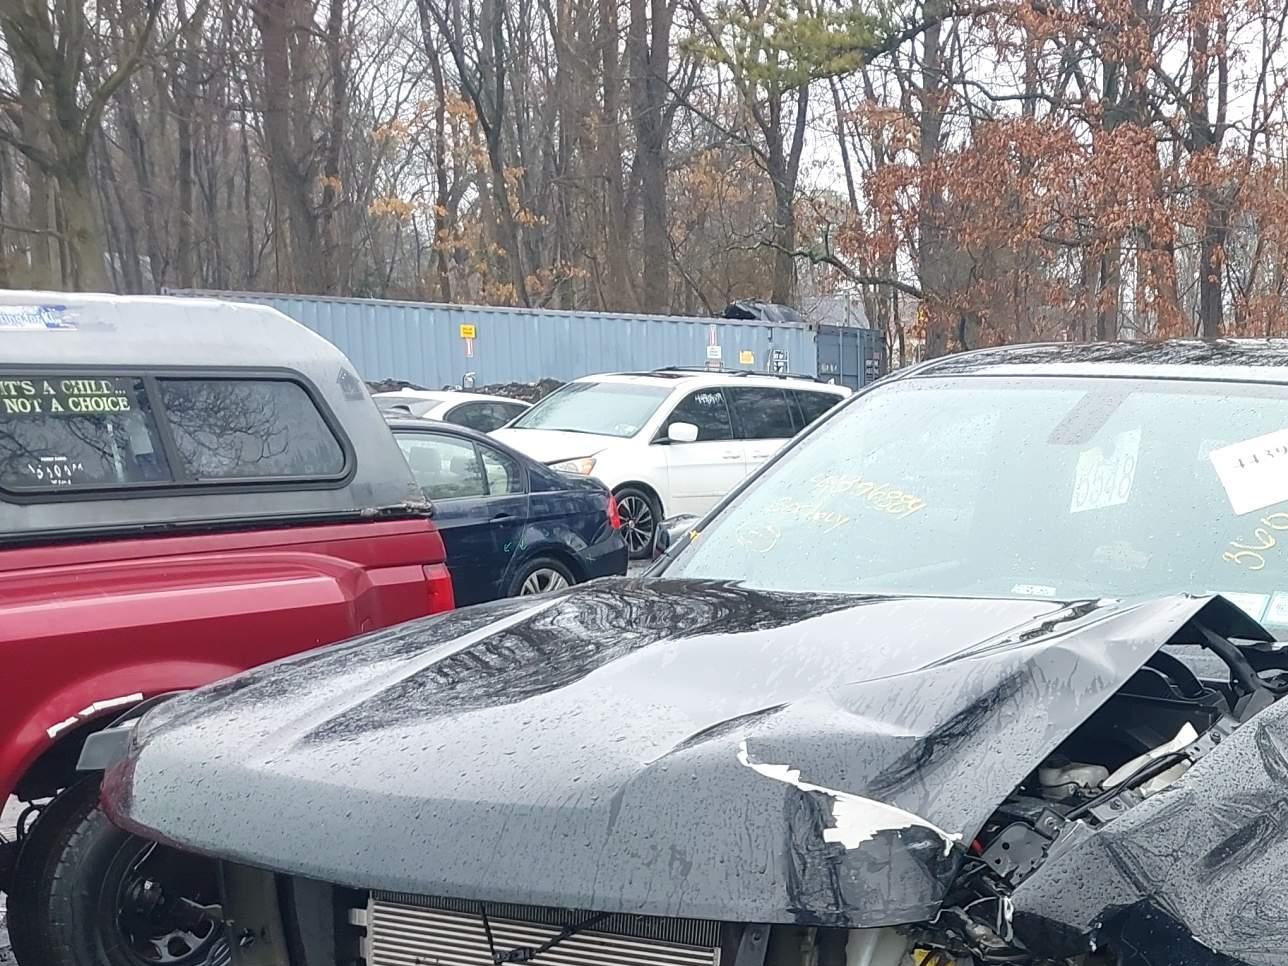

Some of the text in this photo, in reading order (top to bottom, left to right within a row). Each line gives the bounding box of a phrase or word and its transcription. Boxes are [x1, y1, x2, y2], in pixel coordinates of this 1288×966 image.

[43, 380, 56, 395] A
[3, 396, 131, 413] NOT A CHOICE
